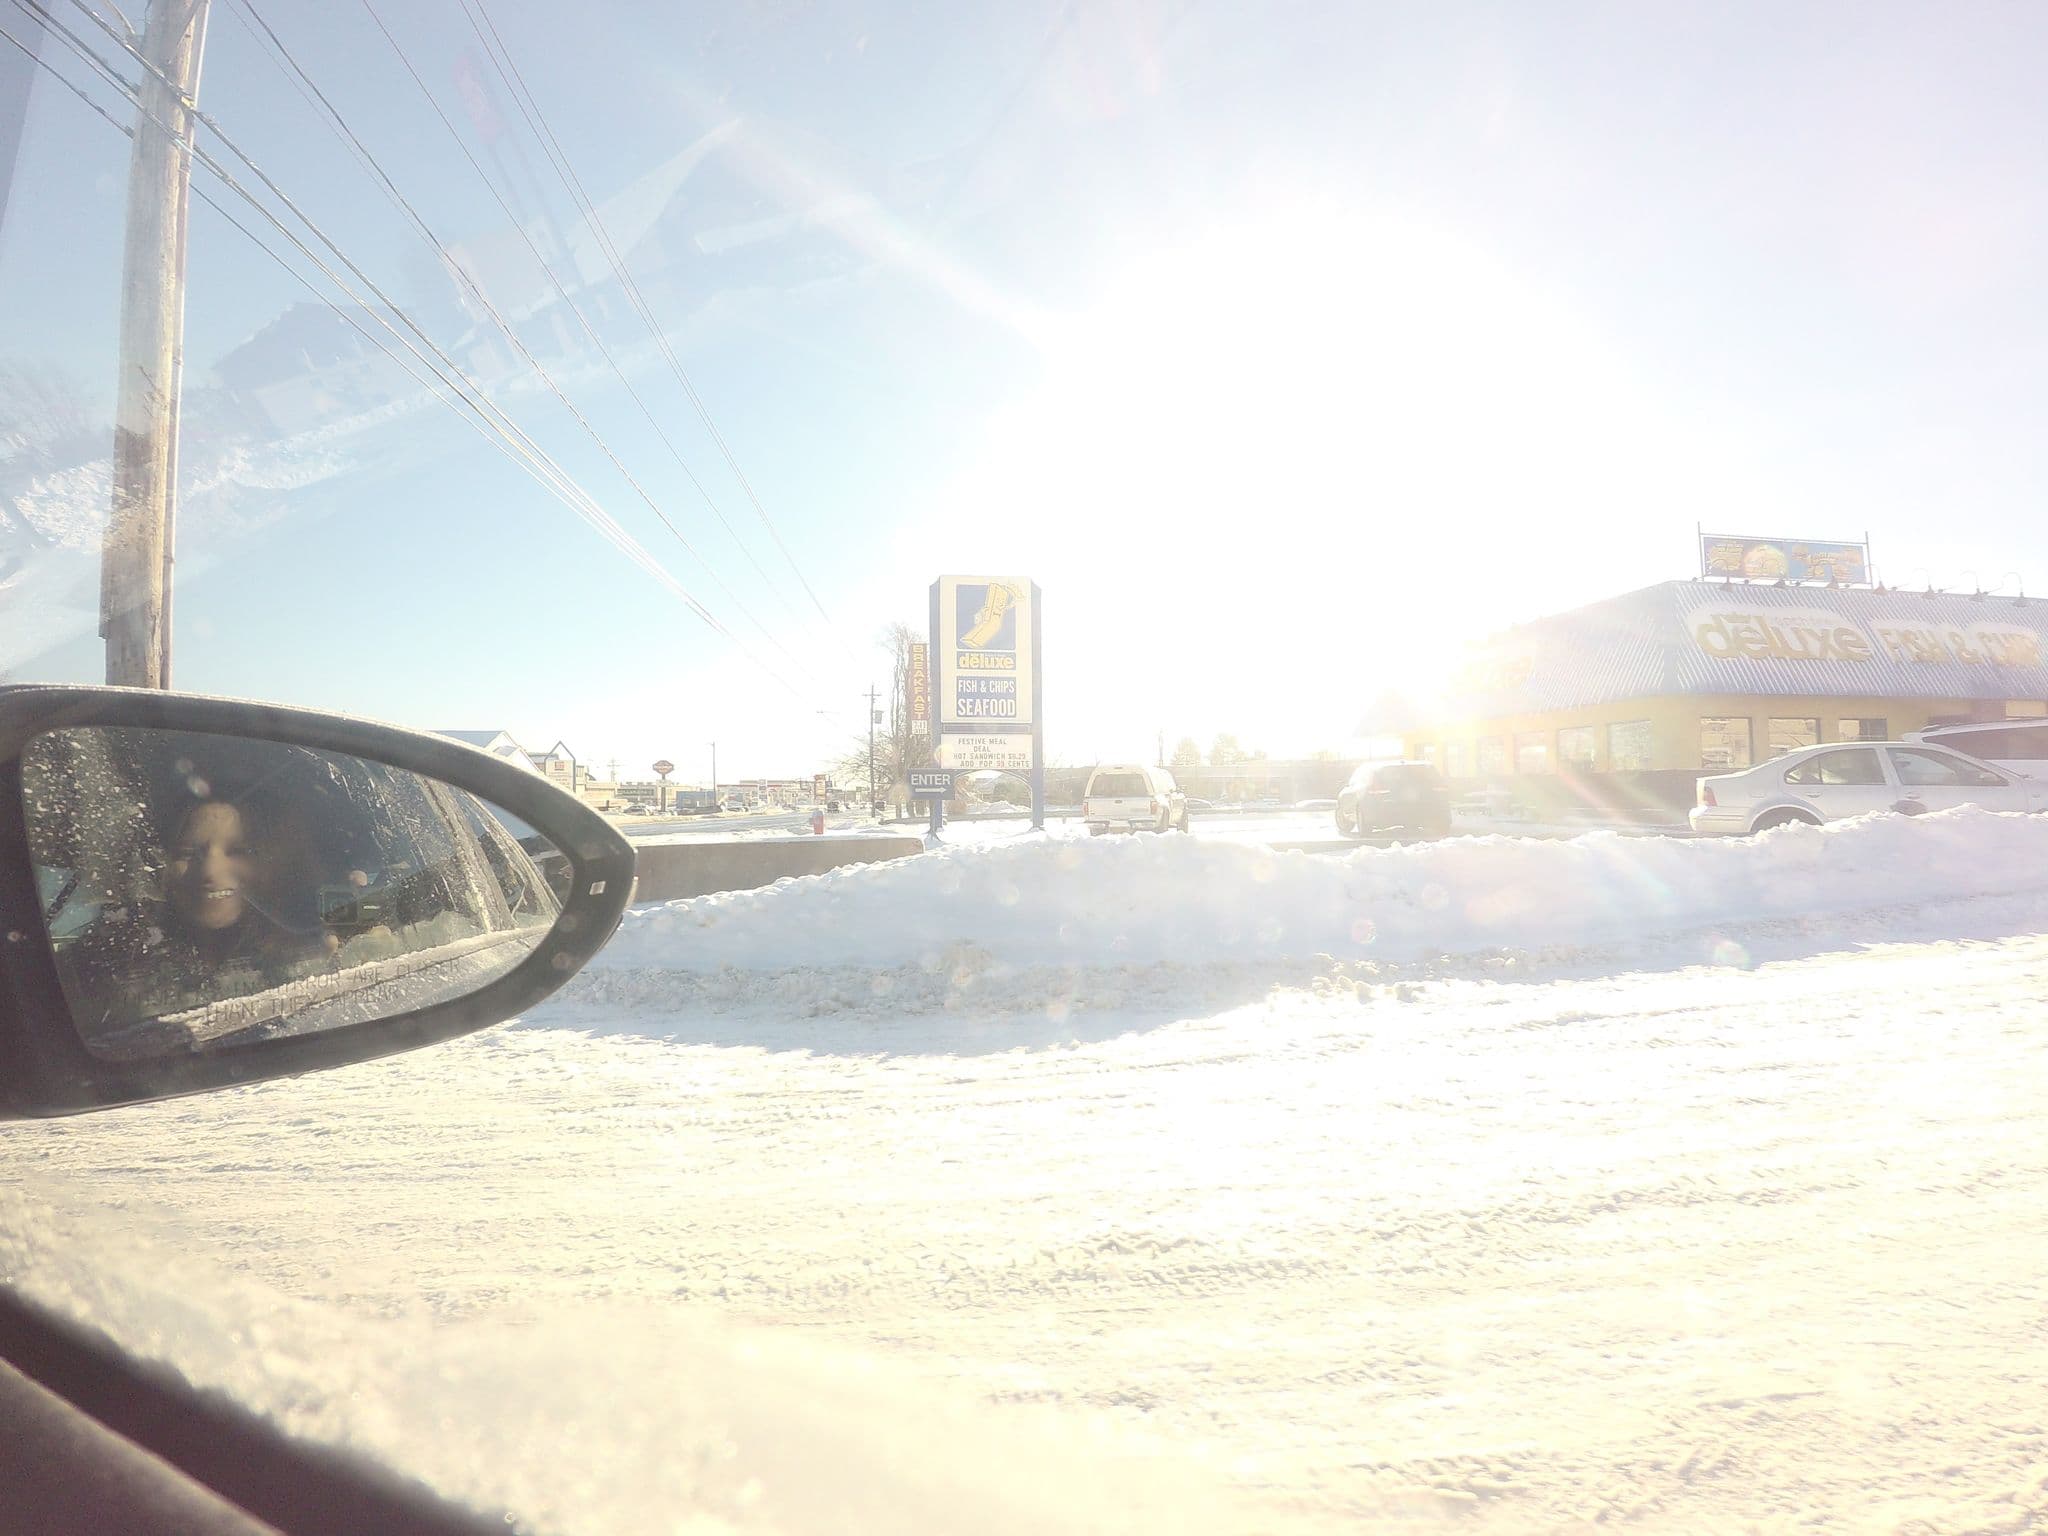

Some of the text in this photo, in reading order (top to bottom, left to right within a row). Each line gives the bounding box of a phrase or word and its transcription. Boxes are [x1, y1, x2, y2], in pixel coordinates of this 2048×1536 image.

[912, 645, 925, 719] BREAKFAST
[958, 679, 1015, 693] FISH & CHIPS
[957, 698, 1016, 716] SEAFOOD
[911, 773, 951, 785] ENTER
